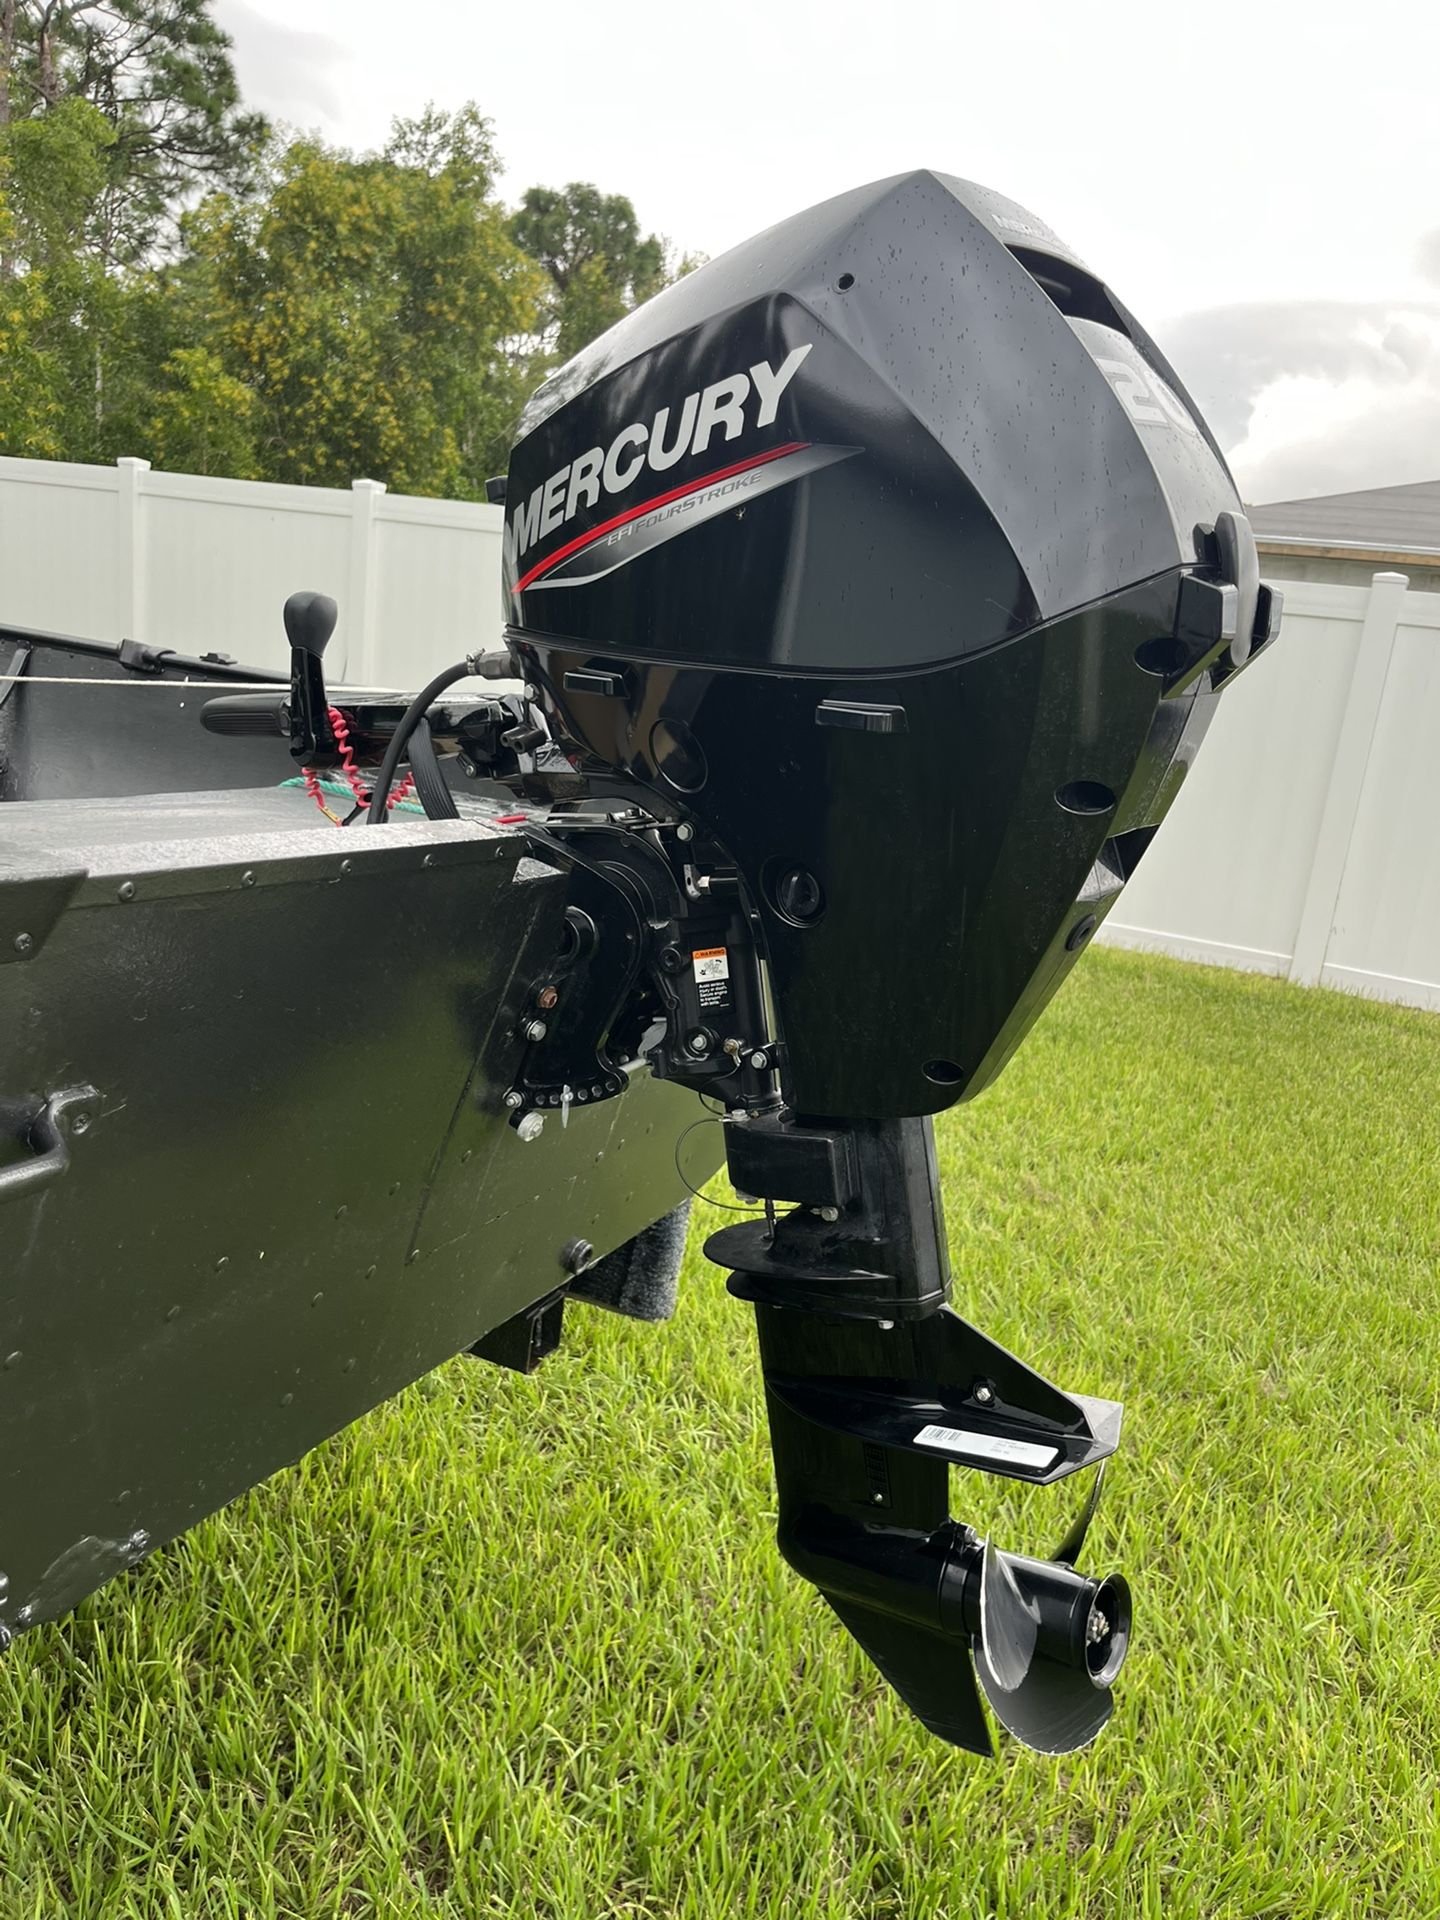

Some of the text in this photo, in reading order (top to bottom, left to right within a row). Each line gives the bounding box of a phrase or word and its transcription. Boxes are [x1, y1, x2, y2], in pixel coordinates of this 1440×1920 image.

[511, 343, 813, 565] MERCURY
[607, 469, 763, 546] EFI FOURSTROKE
[700, 949, 724, 957] WARNING
